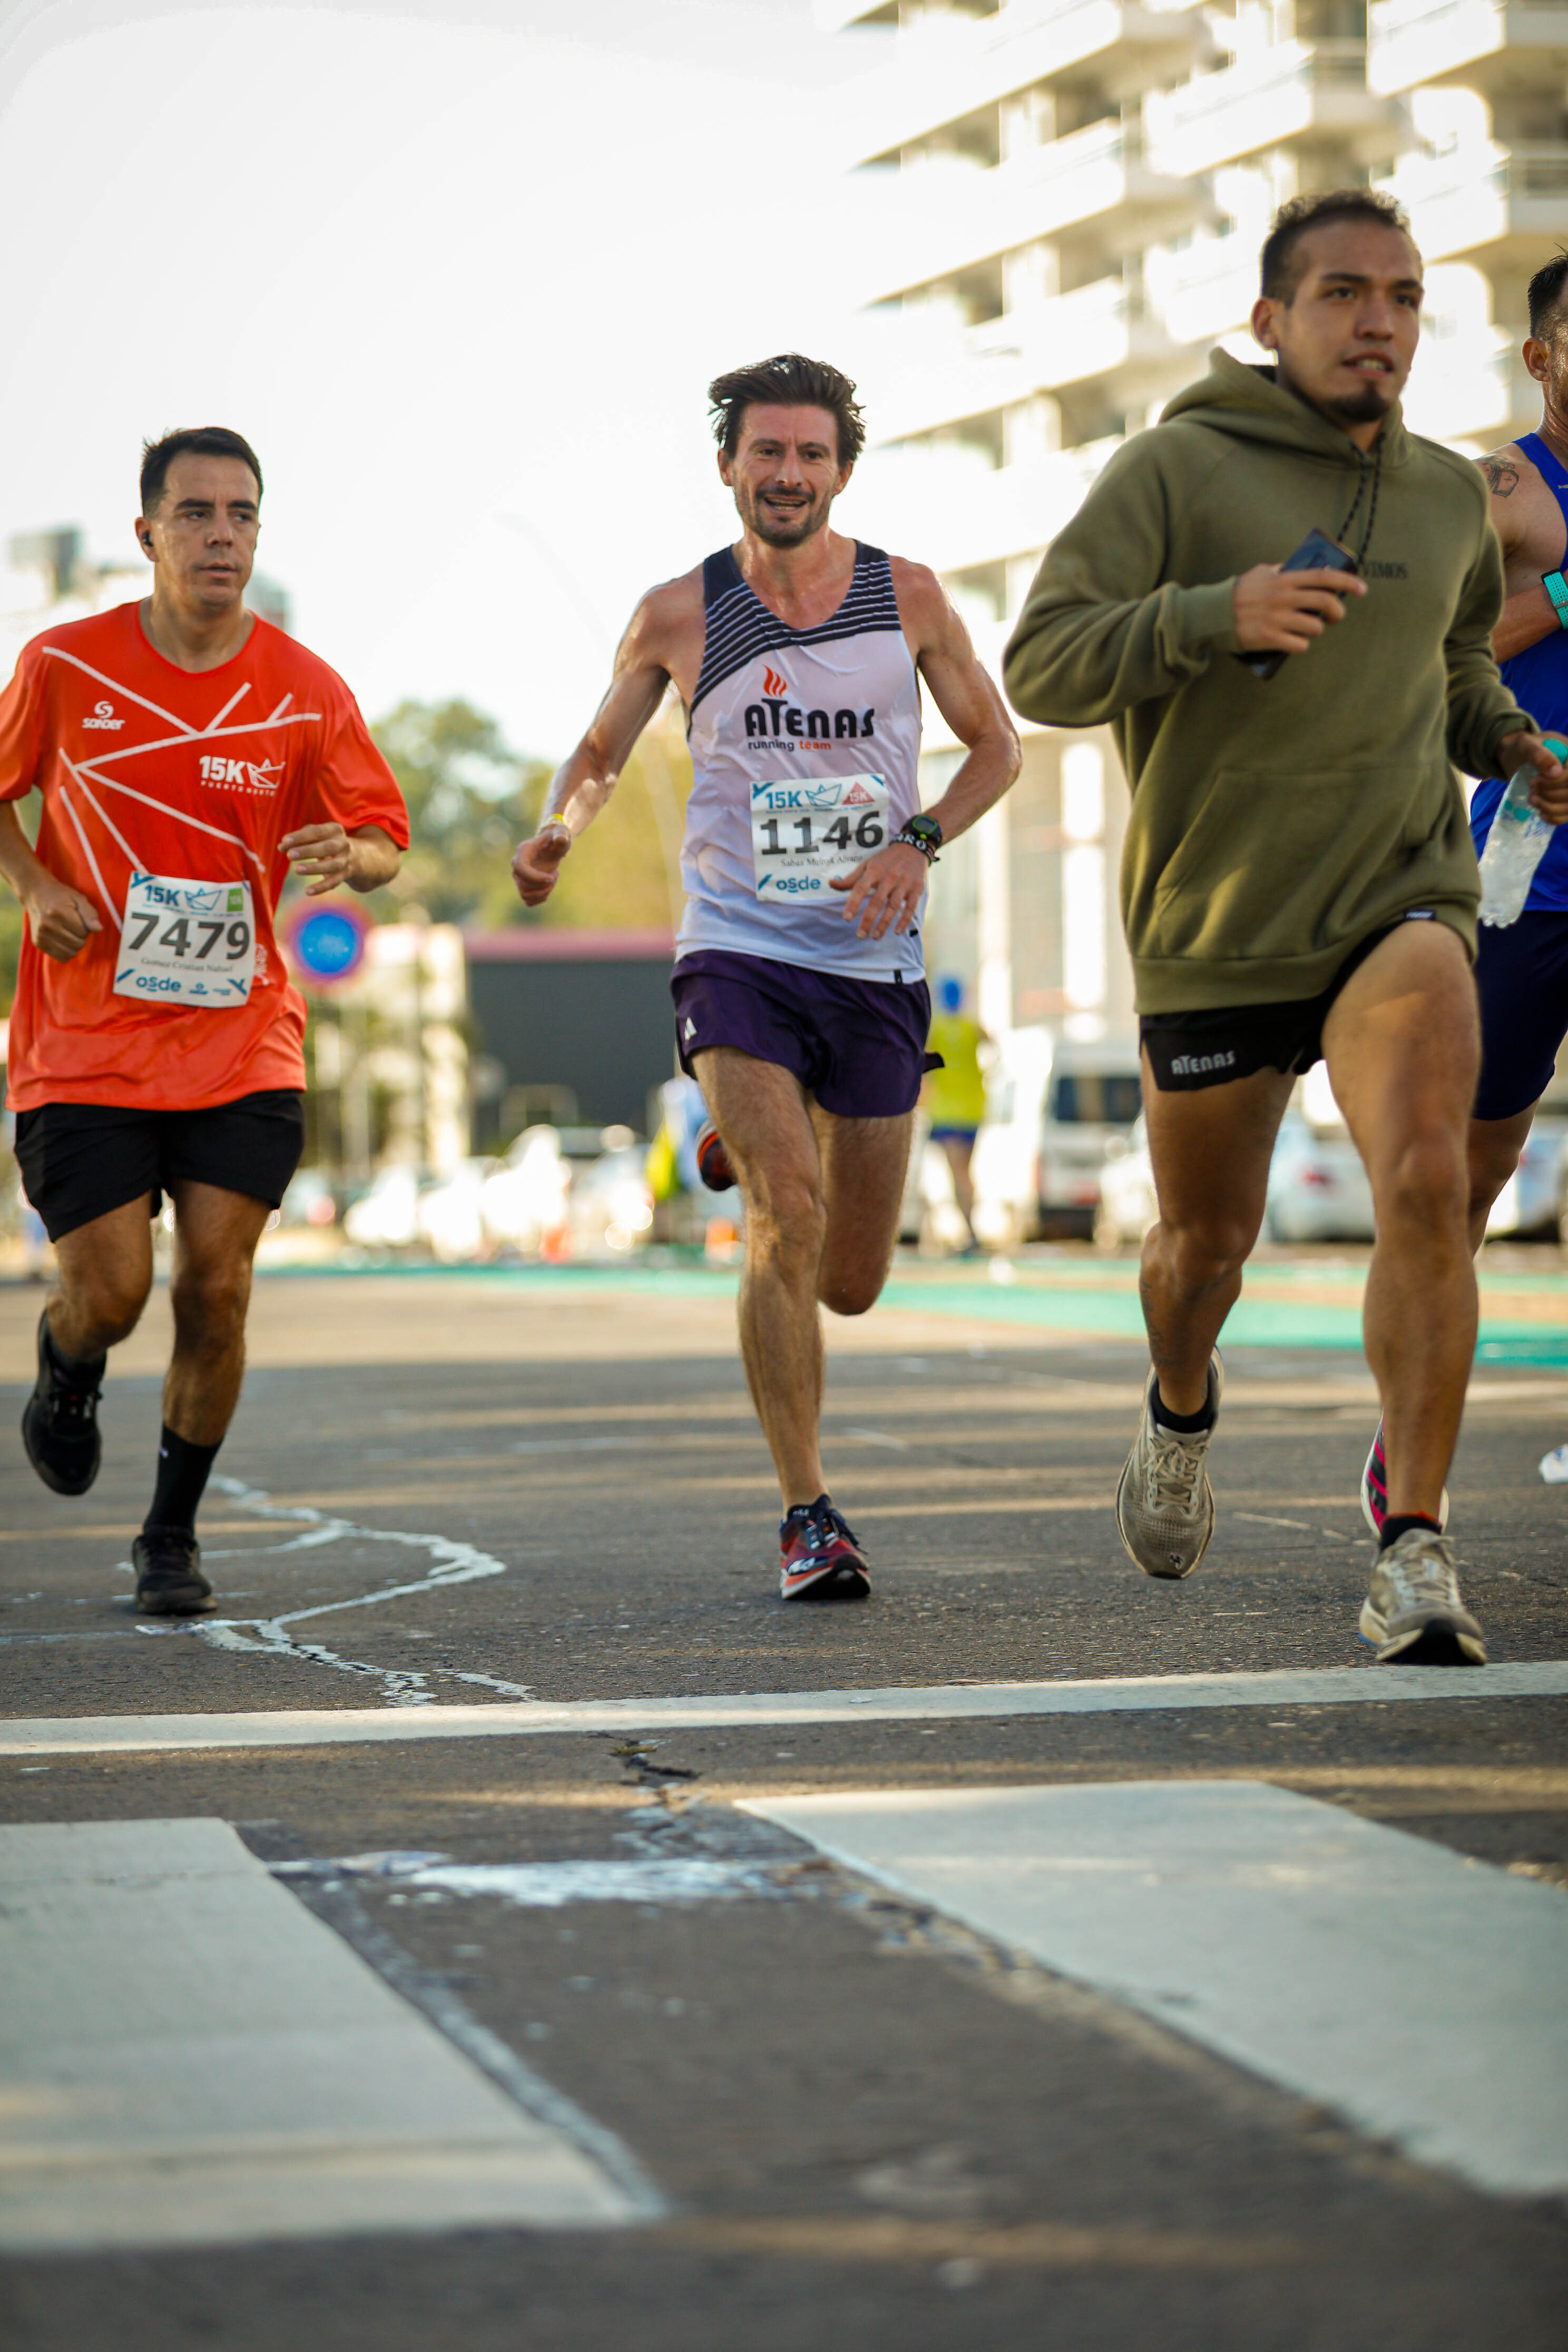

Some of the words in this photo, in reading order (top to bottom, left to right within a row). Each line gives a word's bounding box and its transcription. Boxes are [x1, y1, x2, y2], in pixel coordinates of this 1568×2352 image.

[748, 740, 795, 752] running
[799, 740, 831, 750] team
[199, 755, 246, 784] 15K
[766, 790, 802, 809] 15K
[849, 791, 868, 802] 15K
[760, 810, 883, 855] 1146
[776, 875, 820, 893] osde
[144, 885, 180, 906] 15K
[129, 912, 250, 960] 7479
[136, 976, 181, 992] osde
